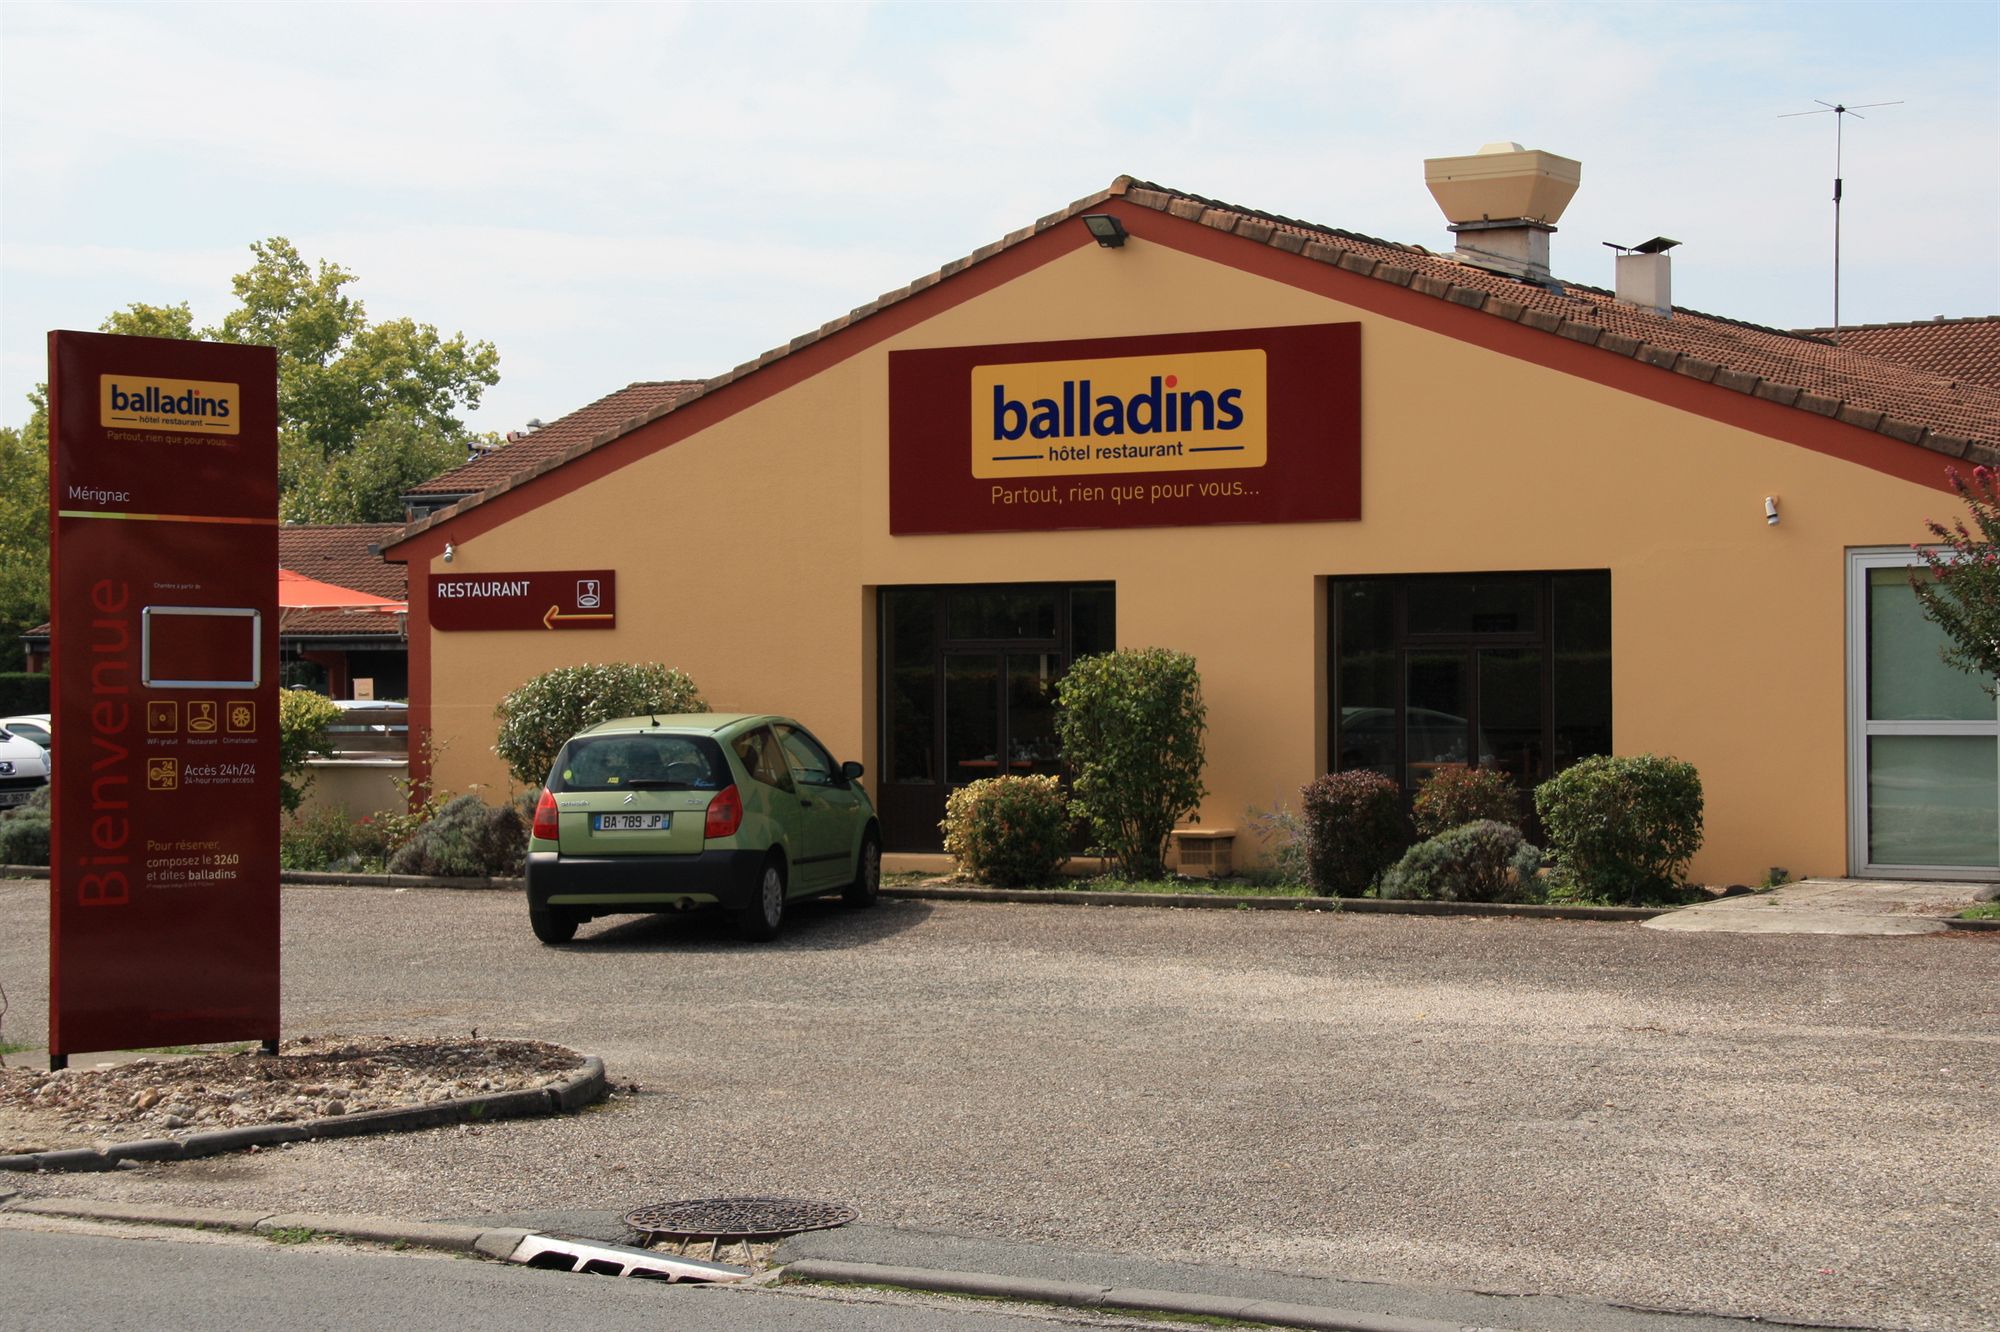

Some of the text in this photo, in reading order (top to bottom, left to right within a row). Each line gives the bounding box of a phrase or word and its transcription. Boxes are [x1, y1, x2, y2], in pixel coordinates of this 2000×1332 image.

[111, 383, 230, 418] balladins
[993, 374, 1244, 441] balladins
[139, 415, 203, 427] hôtel restaurant
[145, 432, 164, 442] rien
[166, 435, 182, 446] que
[184, 436, 204, 447] pour
[1048, 441, 1184, 462] hôtel restaurant
[68, 485, 130, 505] Mérignac
[991, 481, 1260, 505] Partout, rien que pour vous...
[437, 580, 530, 598] RESTAURANT
[78, 578, 129, 907] Bienvenue
[162, 760, 173, 771] 24
[184, 762, 256, 776] Accès 24h/24
[162, 777, 173, 788] 24
[184, 776, 211, 785] 24-hour
[231, 776, 255, 784] access
[147, 840, 172, 851] Pour
[146, 854, 239, 869] composez le 3260
[146, 868, 237, 881] et dites balladins
